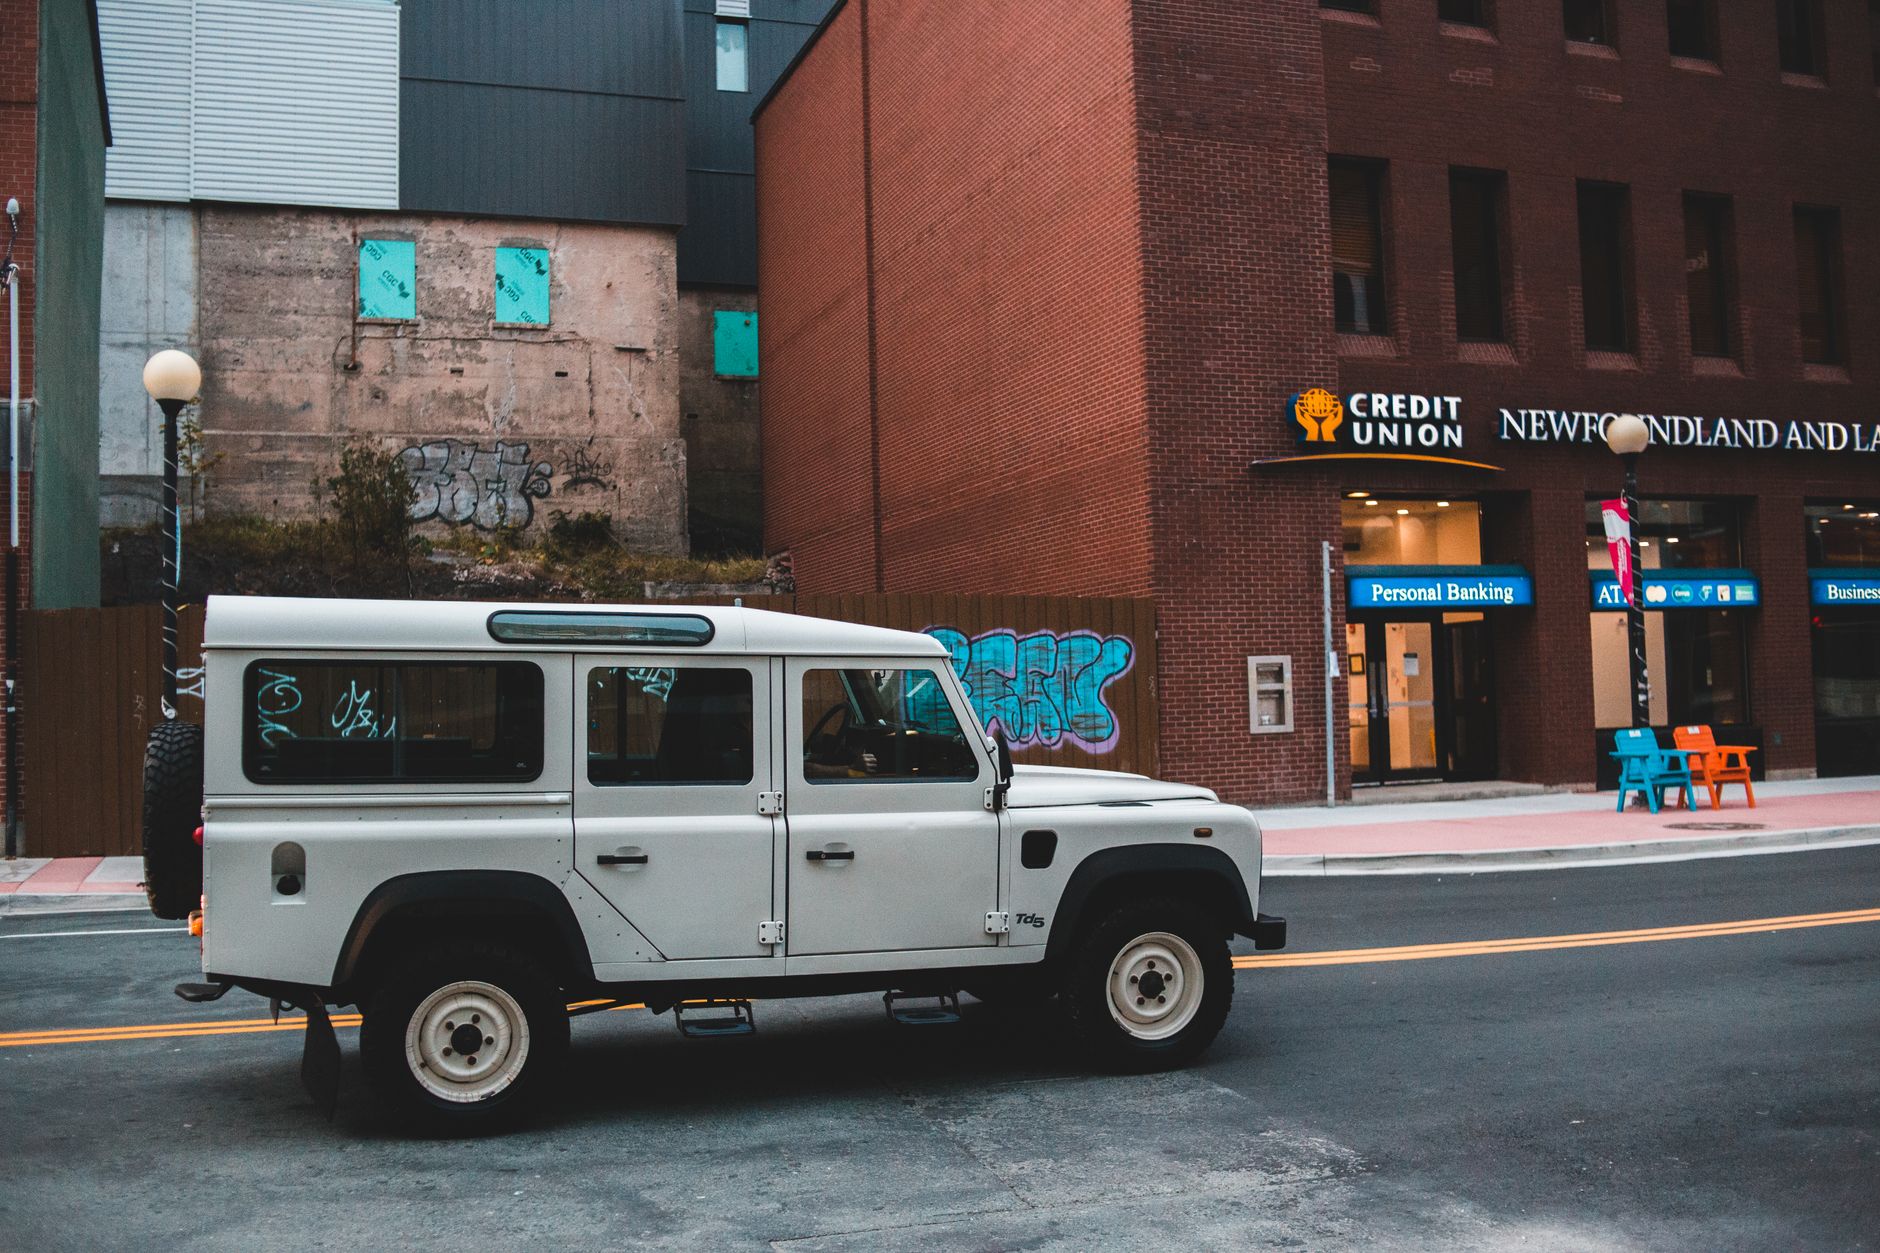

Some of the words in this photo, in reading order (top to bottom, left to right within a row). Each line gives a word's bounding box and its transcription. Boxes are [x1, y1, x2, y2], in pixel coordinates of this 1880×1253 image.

[1349, 392, 1463, 421] CREDIT
[1352, 421, 1464, 448] UNION
[1784, 420, 1849, 450] AND
[1371, 583, 1442, 602] Personal
[1447, 583, 1515, 604] Banking
[1016, 913, 1045, 928] Td5
